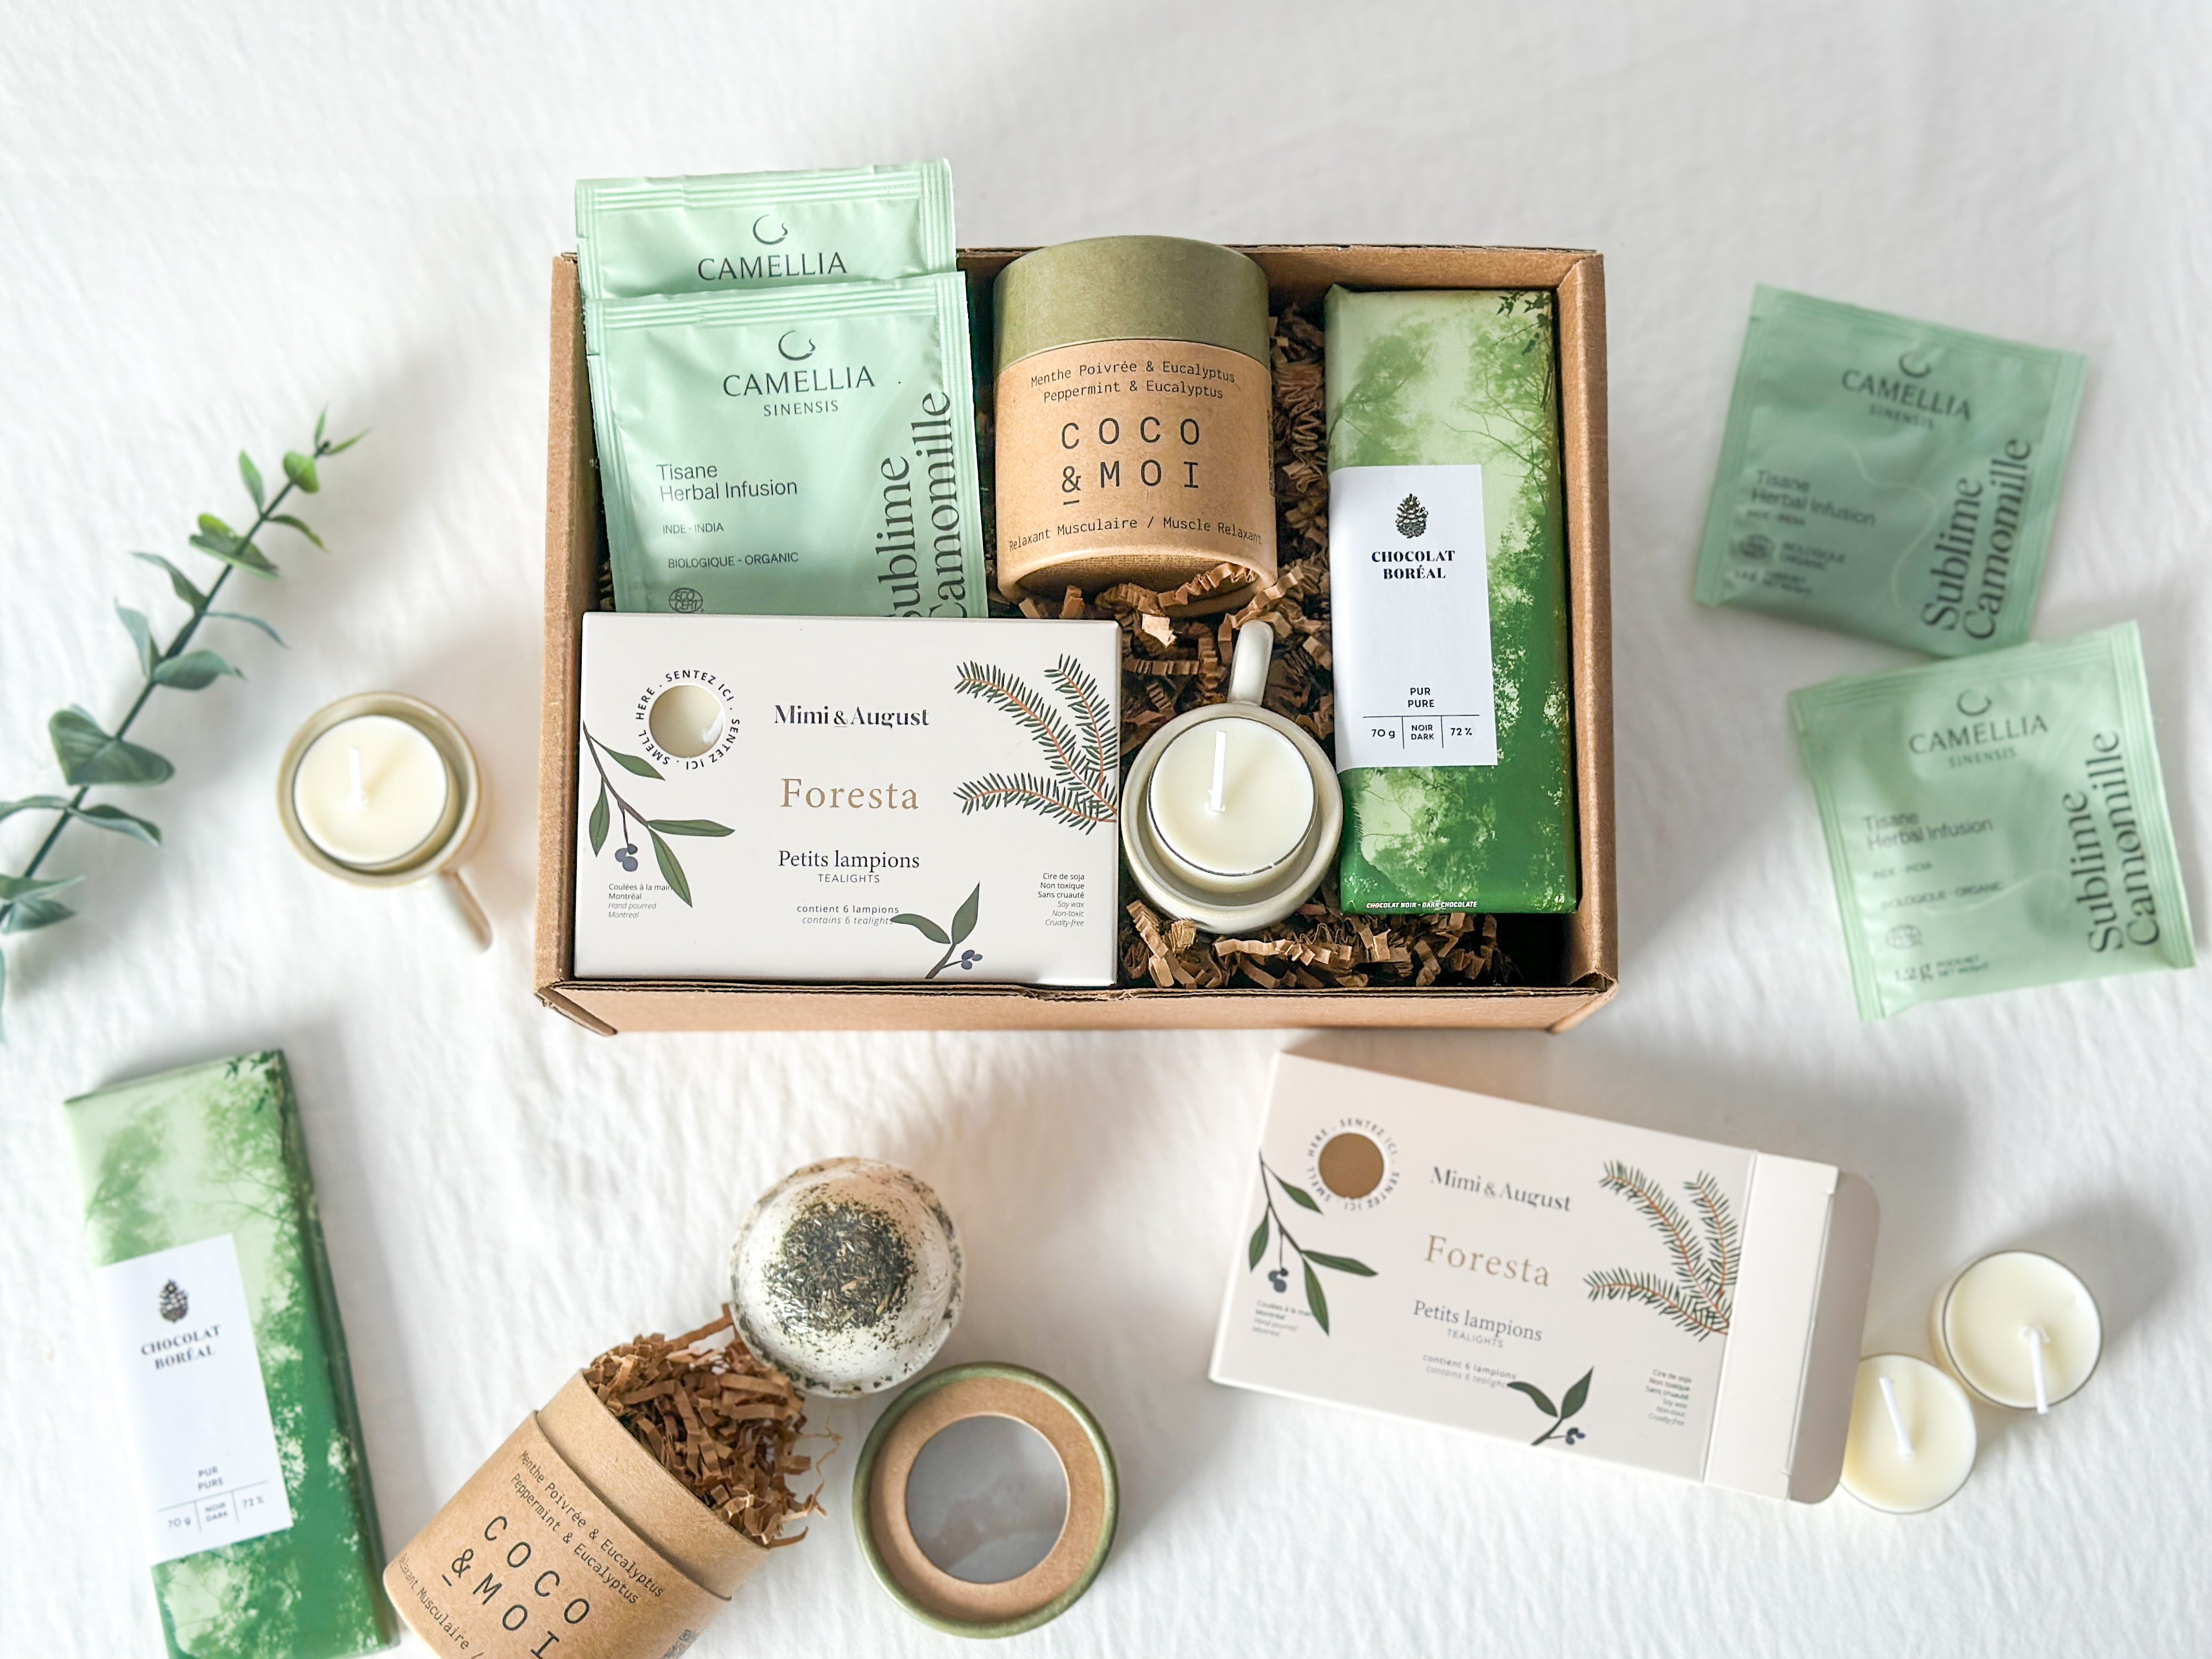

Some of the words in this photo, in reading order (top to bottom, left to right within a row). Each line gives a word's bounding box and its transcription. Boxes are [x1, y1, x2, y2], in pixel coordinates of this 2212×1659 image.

[698, 252, 847, 281] CAMELLIA
[723, 365, 876, 397] CAMELLIA
[1031, 370, 1071, 388] Menthe
[1079, 361, 1137, 375] Poivrée
[1146, 361, 1154, 372] &
[1162, 361, 1235, 383] Eucalyptus
[1044, 382, 1120, 403] Peppermint
[1129, 381, 1138, 392] &
[1146, 381, 1224, 399] Eucalyptus
[1842, 369, 1971, 421] CAMELLIA
[763, 400, 839, 417] SINENSIS
[1061, 416, 1200, 450] COCO
[657, 463, 718, 482] Tisane
[1757, 470, 1810, 492] Tisane
[660, 485, 720, 502] Herbal
[725, 479, 798, 498] Infusion
[1809, 499, 1876, 526] Infusion
[663, 524, 686, 534] INDE
[695, 522, 724, 533] INDIA
[876, 456, 921, 617] ublime
[1009, 529, 1051, 552] Relaxant
[1058, 519, 1138, 536] Musculaire
[1164, 516, 1211, 532] Muscle
[1217, 522, 1262, 544] Relaxant
[1963, 439, 2031, 640] Camomille
[668, 556, 735, 568] BIOLOGIQUE
[745, 552, 799, 564] ORGANIC
[1372, 550, 1455, 563] CHOCOLAT
[1921, 477, 1983, 631] Sublime
[1383, 565, 1446, 580] BORÉAL
[675, 591, 695, 601] ECO
[665, 669, 717, 685] SENTEZ
[718, 683, 735, 702] ICI
[1410, 687, 1430, 696] PUR
[635, 687, 656, 720] HERE
[1407, 699, 1435, 708] PURE
[774, 705, 829, 724] Mimi
[851, 706, 930, 729] August
[708, 718, 740, 763] SENTEZ
[1372, 729, 1386, 738] 70
[1389, 731, 1395, 739] g
[1450, 728, 1462, 736] 72
[1465, 728, 1472, 736] %
[1909, 714, 2049, 755] CAMELLIA
[638, 730, 671, 765] SMELL
[1949, 747, 2017, 768] SINENSIS
[685, 759, 704, 770] ICI
[780, 778, 919, 810] Foresta
[1867, 829, 1925, 850] Herbal
[1927, 818, 1993, 841] Infusion
[2085, 732, 2161, 947] Camomille
[779, 850, 828, 866] Petits
[834, 850, 920, 872] lampions
[818, 874, 880, 883] TEALIGHTS
[2062, 793, 2124, 953] Sublime
[802, 916, 841, 924] contains
[854, 917, 893, 926] tealights
[853, 905, 899, 915] lampions
[1340, 1118, 1385, 1136] SENTEZ
[1431, 1166, 1481, 1193] Mimi
[1499, 1182, 1571, 1211] August
[1424, 1234, 1550, 1287] Foresta
[1413, 1300, 1459, 1323] Petits
[1464, 1310, 1542, 1341] lampions
[140, 1325, 221, 1356] CHOCOLAT
[1448, 1329, 1504, 1348] TEALIGHTS
[154, 1345, 216, 1370] BORÉAL
[1423, 1355, 1461, 1368] contient
[1473, 1364, 1516, 1379] lampions
[1426, 1366, 1462, 1379] contains
[198, 1466, 218, 1477] PUR
[198, 1477, 223, 1491] PURE
[205, 1502, 226, 1513] NOIR
[206, 1511, 228, 1522] DARK
[168, 1519, 182, 1528] 70
[519, 1450, 544, 1483] Menthe
[545, 1482, 587, 1528] Poivrée
[588, 1528, 599, 1541] &
[600, 1540, 664, 1597] Eucalyptus
[511, 1474, 560, 1532] Peppermint
[563, 1532, 574, 1545] &
[574, 1544, 640, 1605] Eucalyptus
[484, 1515, 591, 1624] COCO
[418, 1587, 470, 1650] Musculaire
